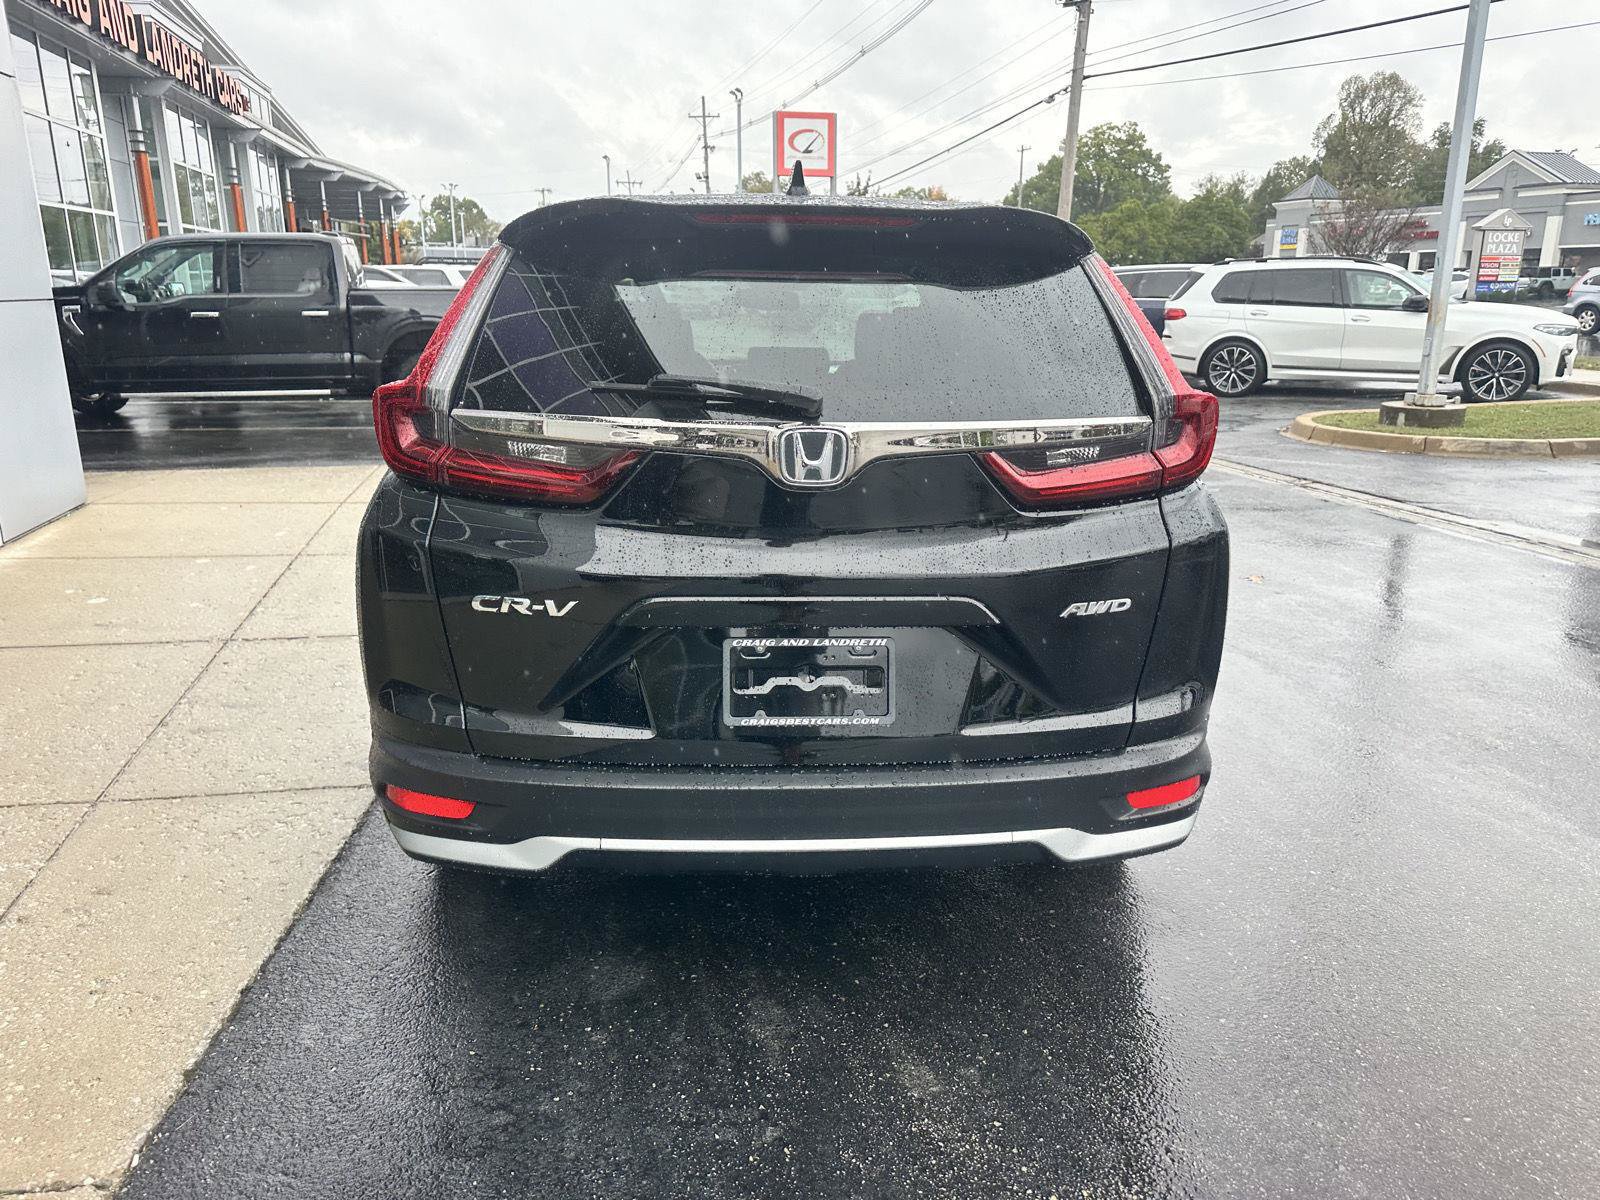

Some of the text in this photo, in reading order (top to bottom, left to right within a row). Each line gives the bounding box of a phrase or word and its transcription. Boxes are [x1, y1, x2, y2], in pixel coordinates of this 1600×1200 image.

[98, 0, 138, 54] AND
[140, 14, 215, 99] LANDRETH
[215, 66, 244, 116] CARS
[1488, 232, 1520, 243] LOCKE
[1486, 244, 1517, 253] PLAZA
[471, 595, 579, 617] CR-V
[1059, 598, 1132, 618] AWD
[732, 638, 888, 647] CRAIG AND LANDRETH
[740, 717, 880, 726] CRAIGSBESTCARS.COM
